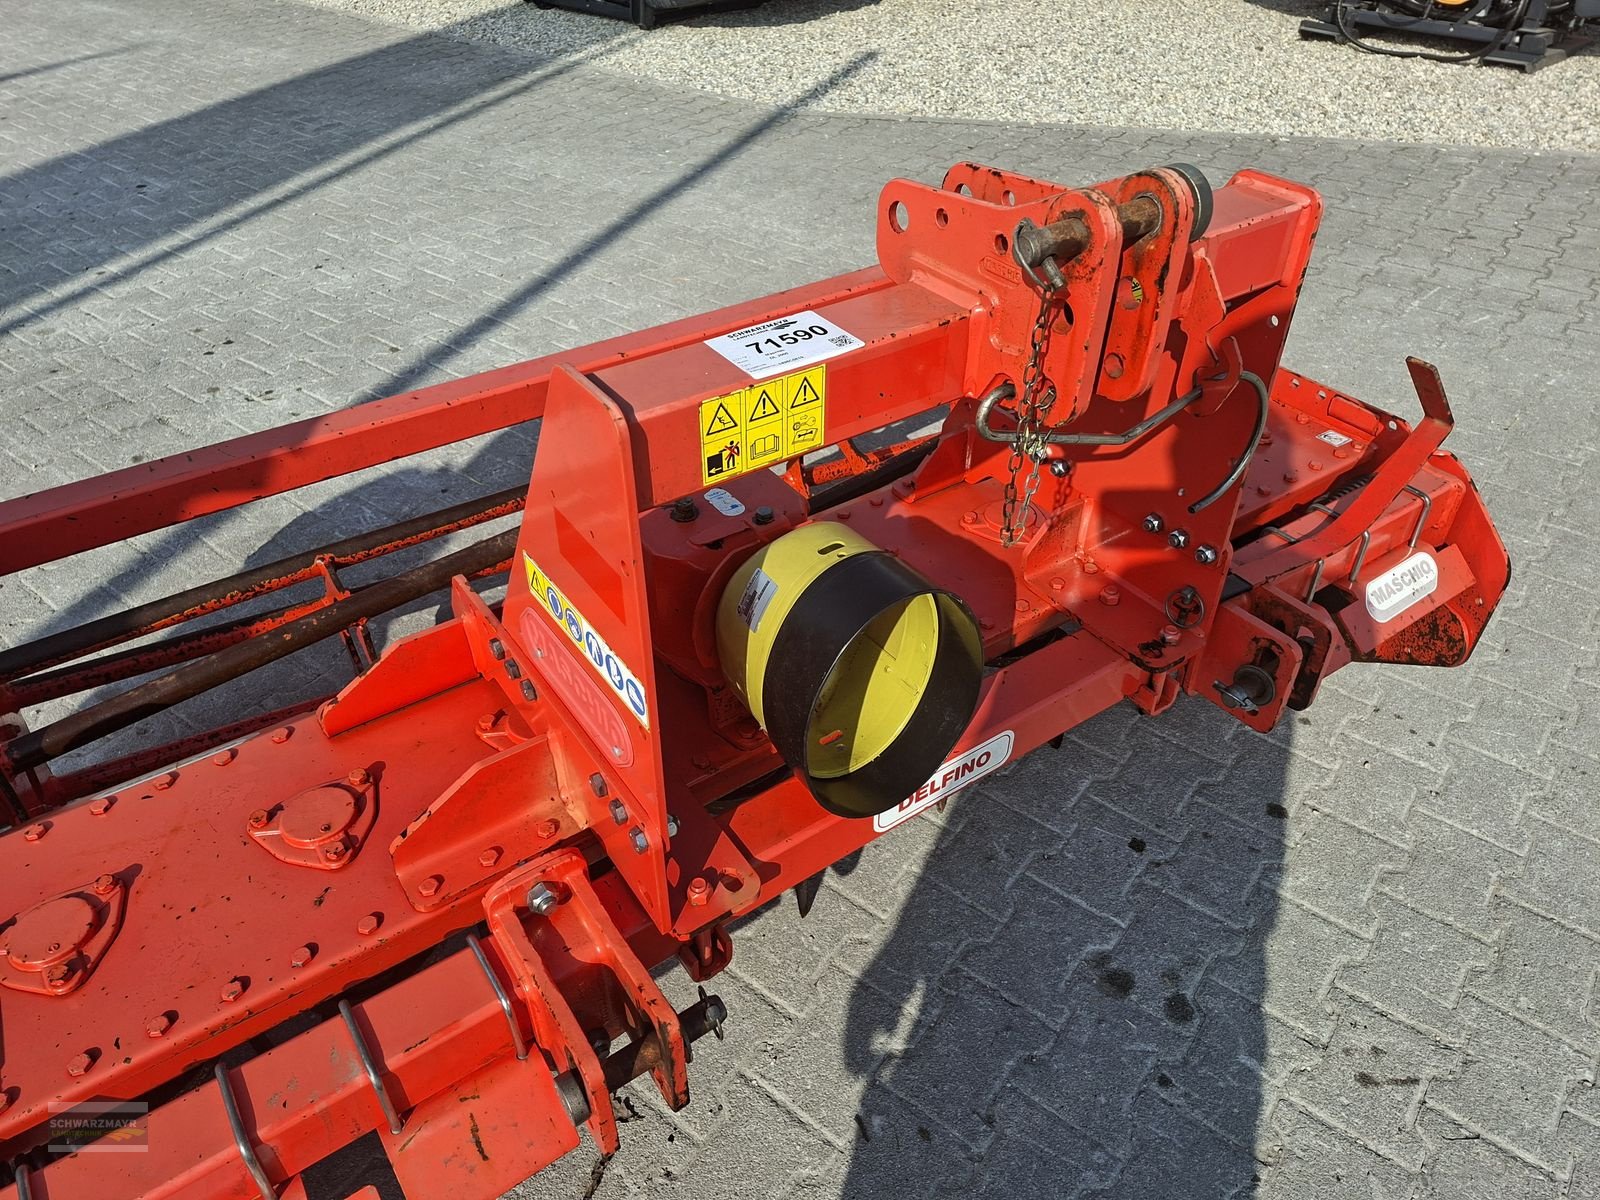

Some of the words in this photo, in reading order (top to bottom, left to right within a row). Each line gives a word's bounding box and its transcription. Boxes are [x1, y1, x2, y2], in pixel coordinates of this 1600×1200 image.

[727, 319, 788, 339] SCHWARZMAYR
[745, 325, 829, 355] 71590
[1371, 560, 1431, 605] MASCHIO
[898, 751, 992, 813] DELFINO
